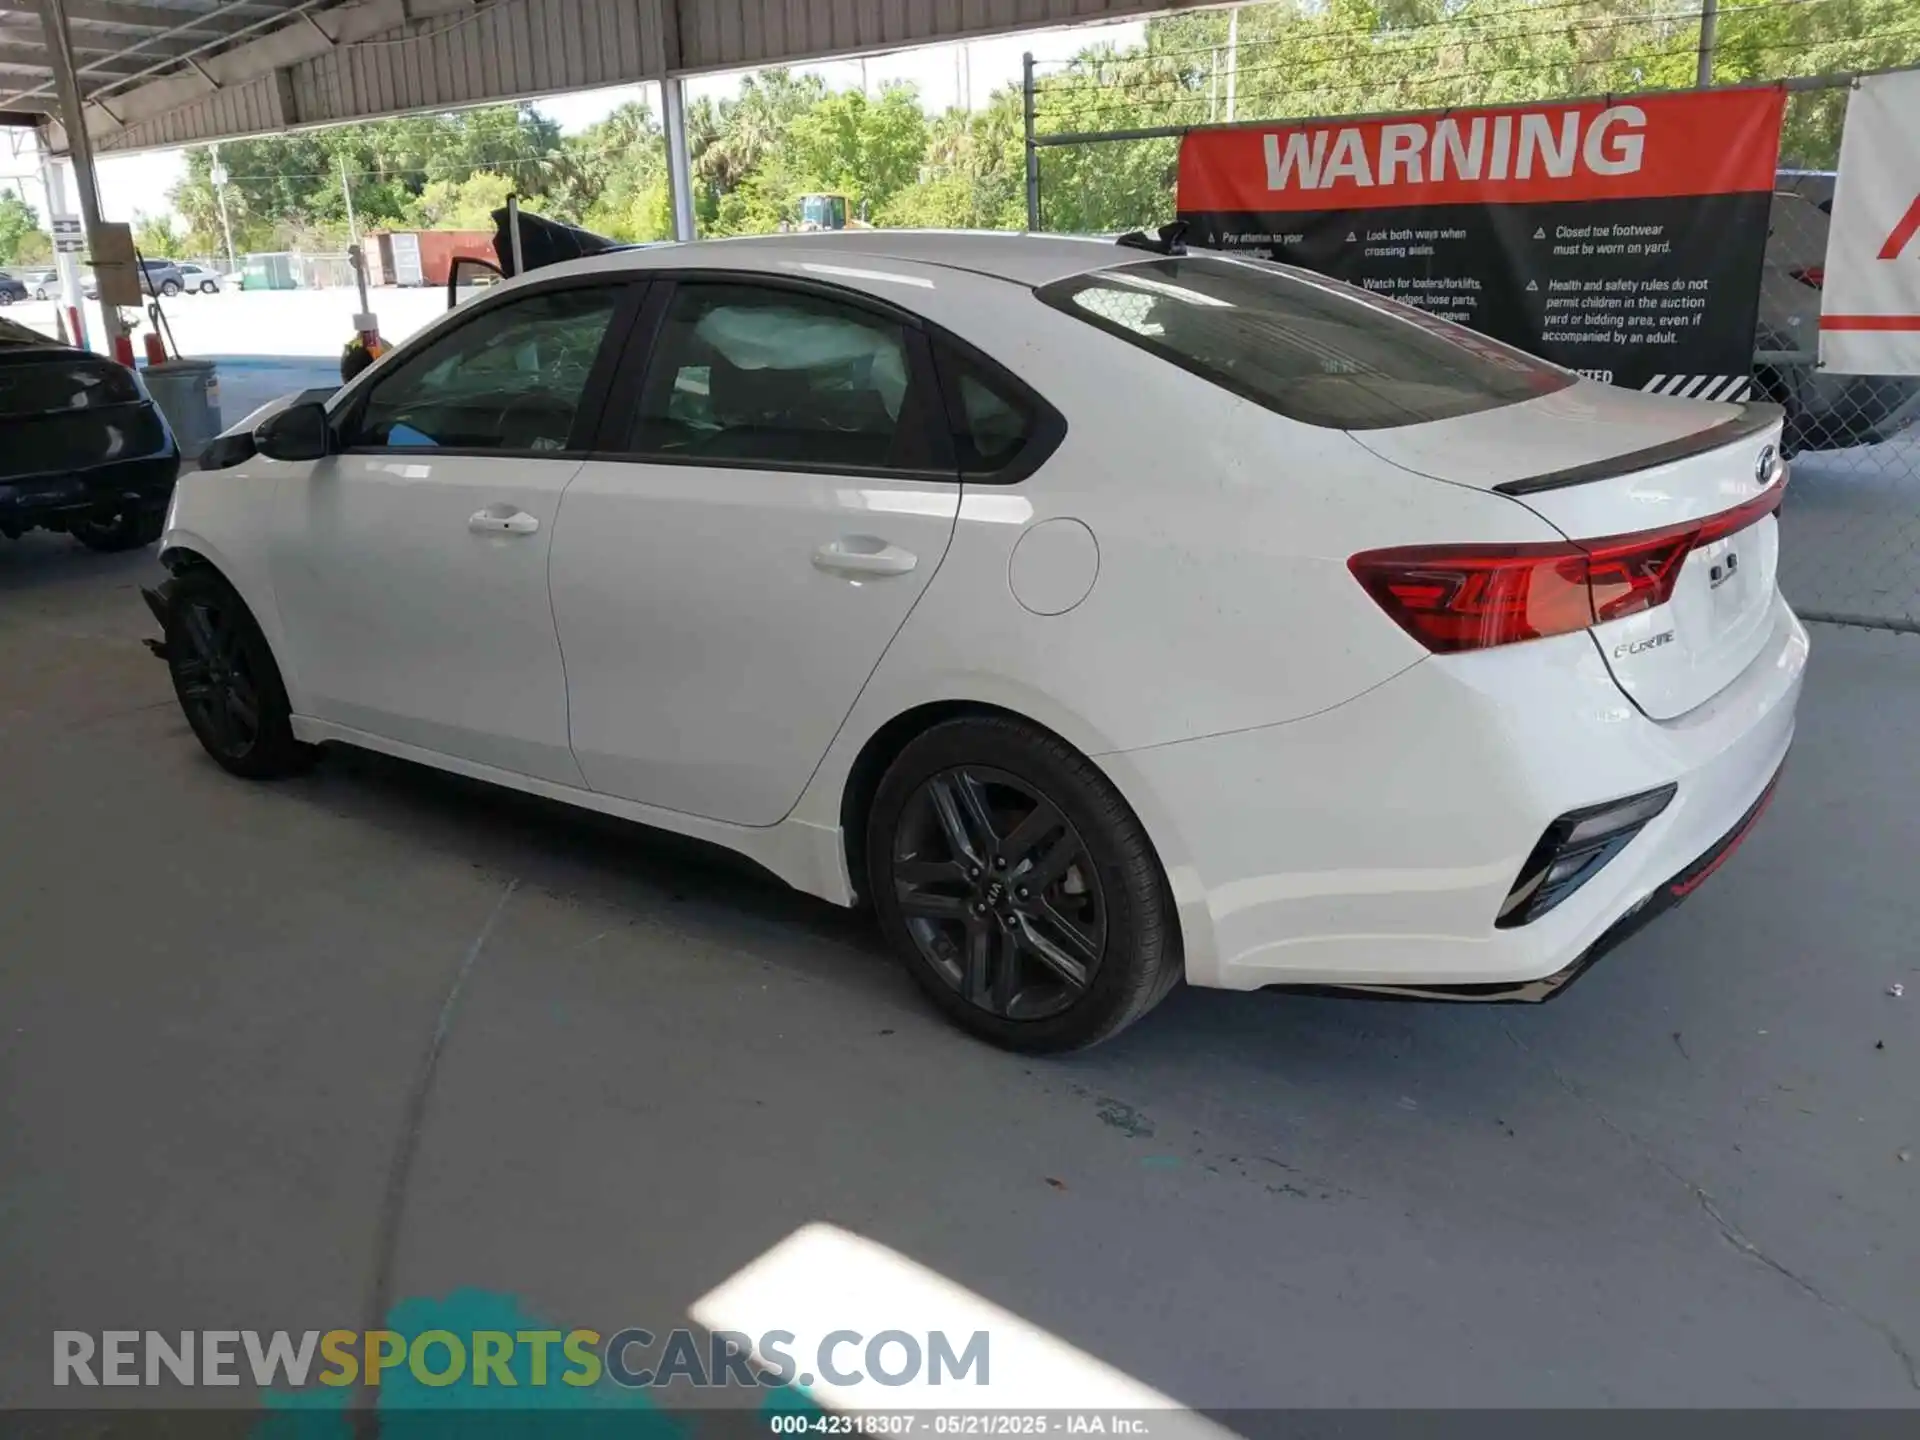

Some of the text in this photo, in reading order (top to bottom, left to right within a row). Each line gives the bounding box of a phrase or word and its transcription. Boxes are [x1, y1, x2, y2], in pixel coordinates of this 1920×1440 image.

[1263, 104, 1647, 190] WARNING
[1367, 228, 1466, 242] Look both ways when
[1556, 224, 1664, 238] Closed toe footwear
[1222, 232, 1239, 244] Pay
[1273, 232, 1282, 243] to
[1283, 234, 1304, 245] your
[1364, 246, 1406, 257] crossing
[1553, 241, 1671, 255] must be worn on yard.
[1363, 278, 1395, 289] Watch
[1397, 278, 1410, 289] for
[1548, 277, 1708, 293] Health and safety rules do not
[1546, 296, 1705, 309] permit children in the auction
[1544, 313, 1703, 327] yard or bidding area, even if
[1542, 331, 1678, 344] accompanied by an adult.
